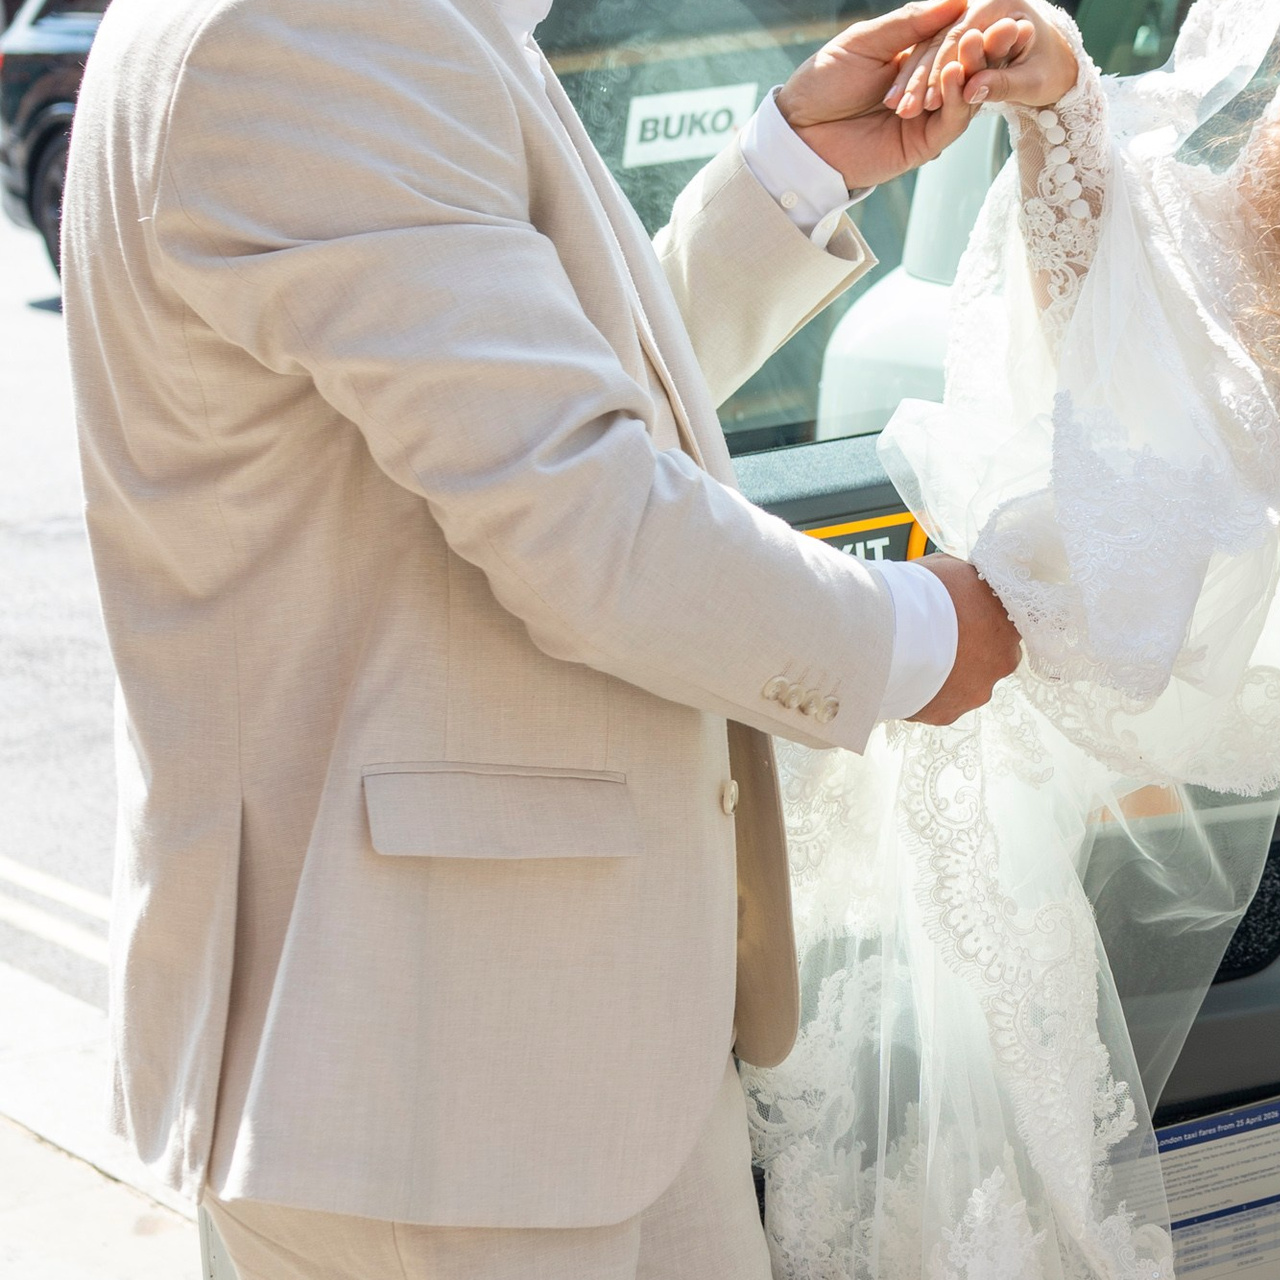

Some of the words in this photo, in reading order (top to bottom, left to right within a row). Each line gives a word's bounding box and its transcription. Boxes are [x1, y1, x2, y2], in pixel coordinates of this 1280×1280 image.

[1183, 1130, 1198, 1140] taxi
[1198, 1127, 1217, 1137] fares
[1217, 1122, 1235, 1132] from
[1245, 1115, 1262, 1125] April
